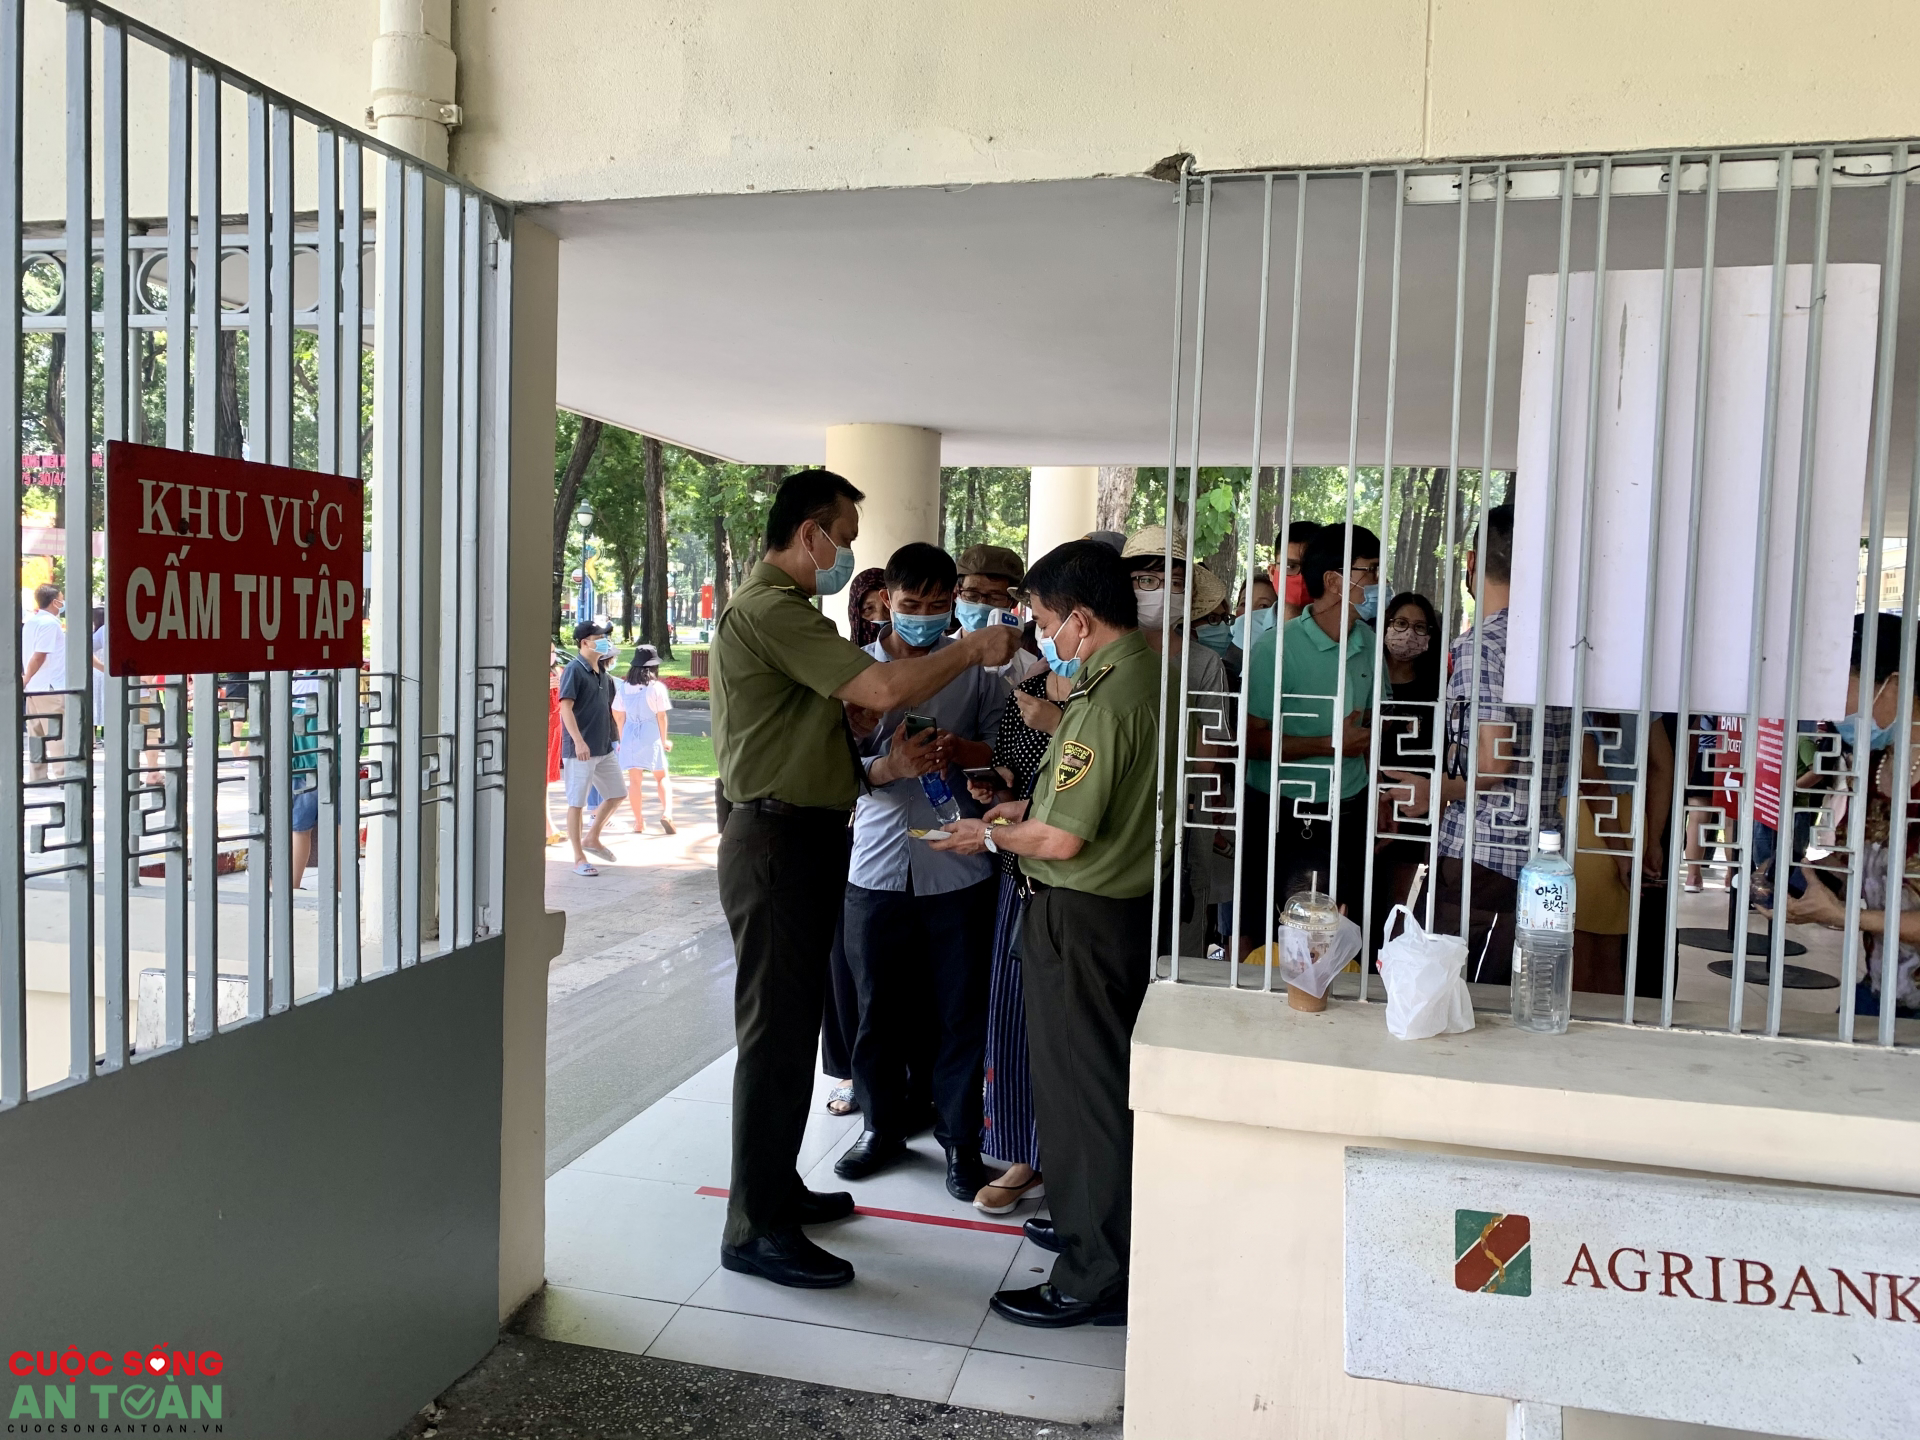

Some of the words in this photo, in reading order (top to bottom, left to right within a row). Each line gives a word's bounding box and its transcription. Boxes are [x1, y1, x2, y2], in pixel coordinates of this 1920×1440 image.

[138, 479, 247, 542] KHU
[260, 489, 343, 562] VỰC
[126, 545, 220, 641] CẤM
[234, 574, 281, 660] TỤ
[293, 564, 355, 659] TẬP
[1535, 884, 1562, 901] 아침
[1542, 899, 1568, 912] 햇살
[1562, 1243, 1920, 1324] AGRIBANK
